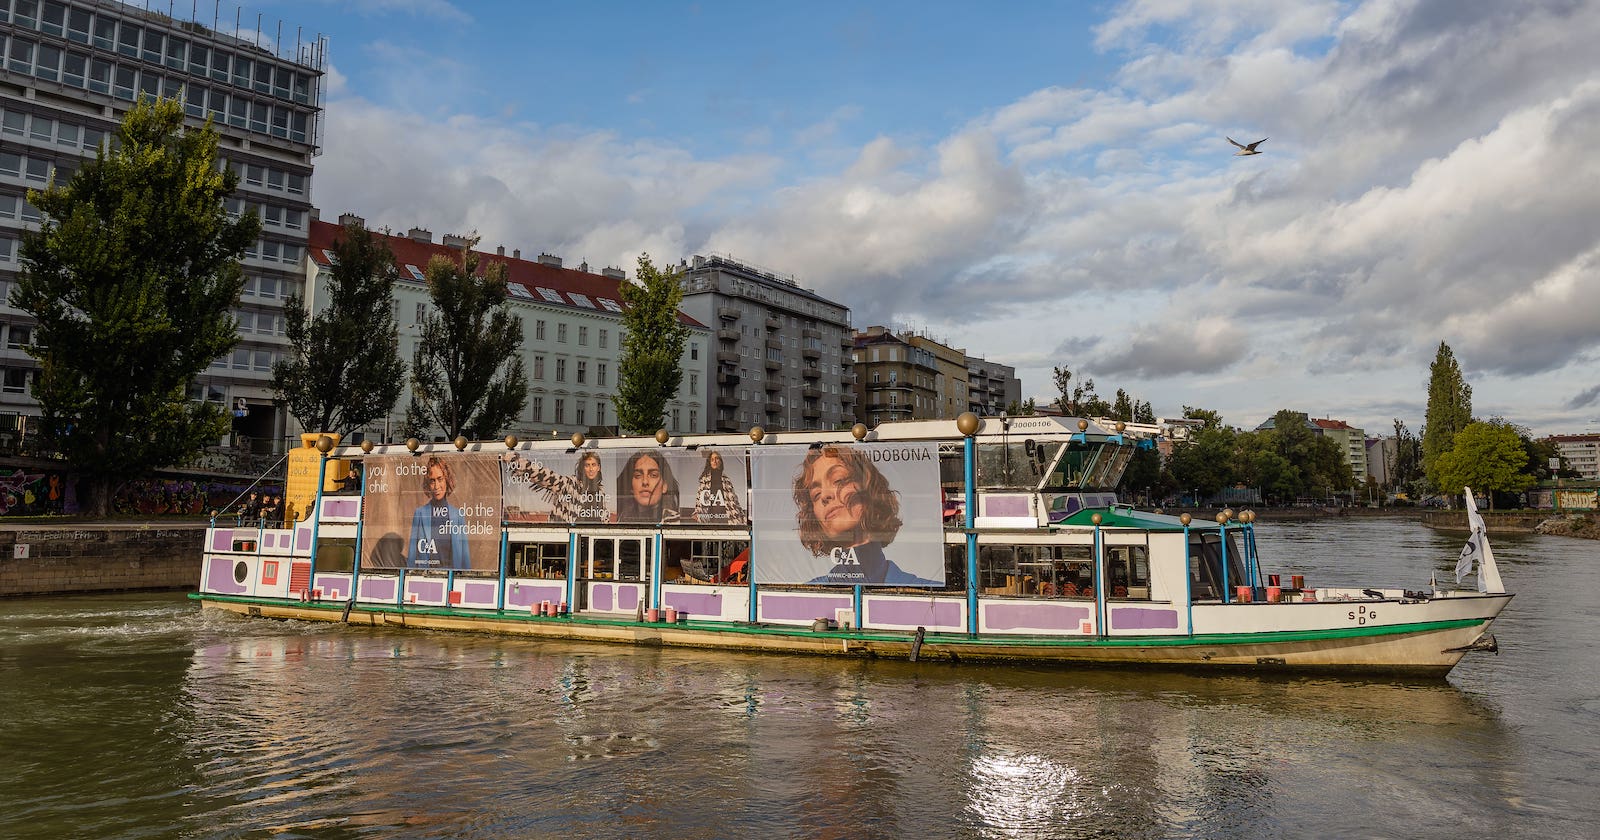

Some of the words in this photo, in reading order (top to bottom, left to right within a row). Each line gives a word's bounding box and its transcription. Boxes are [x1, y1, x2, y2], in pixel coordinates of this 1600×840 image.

[368, 463, 387, 480] you
[395, 462, 410, 476] do
[411, 462, 428, 476] the
[506, 460, 521, 473] you
[530, 459, 543, 470] do
[368, 480, 389, 494] chic
[507, 474, 522, 487] you
[558, 493, 572, 503] we
[581, 490, 594, 503] do
[595, 491, 611, 502] the
[699, 489, 726, 508] C&A
[432, 506, 449, 517] we
[458, 502, 474, 517] do
[475, 502, 494, 517] the
[577, 505, 611, 519] fashion
[438, 520, 494, 535] affordable
[417, 538, 438, 554] C&A
[829, 546, 861, 566] C&A
